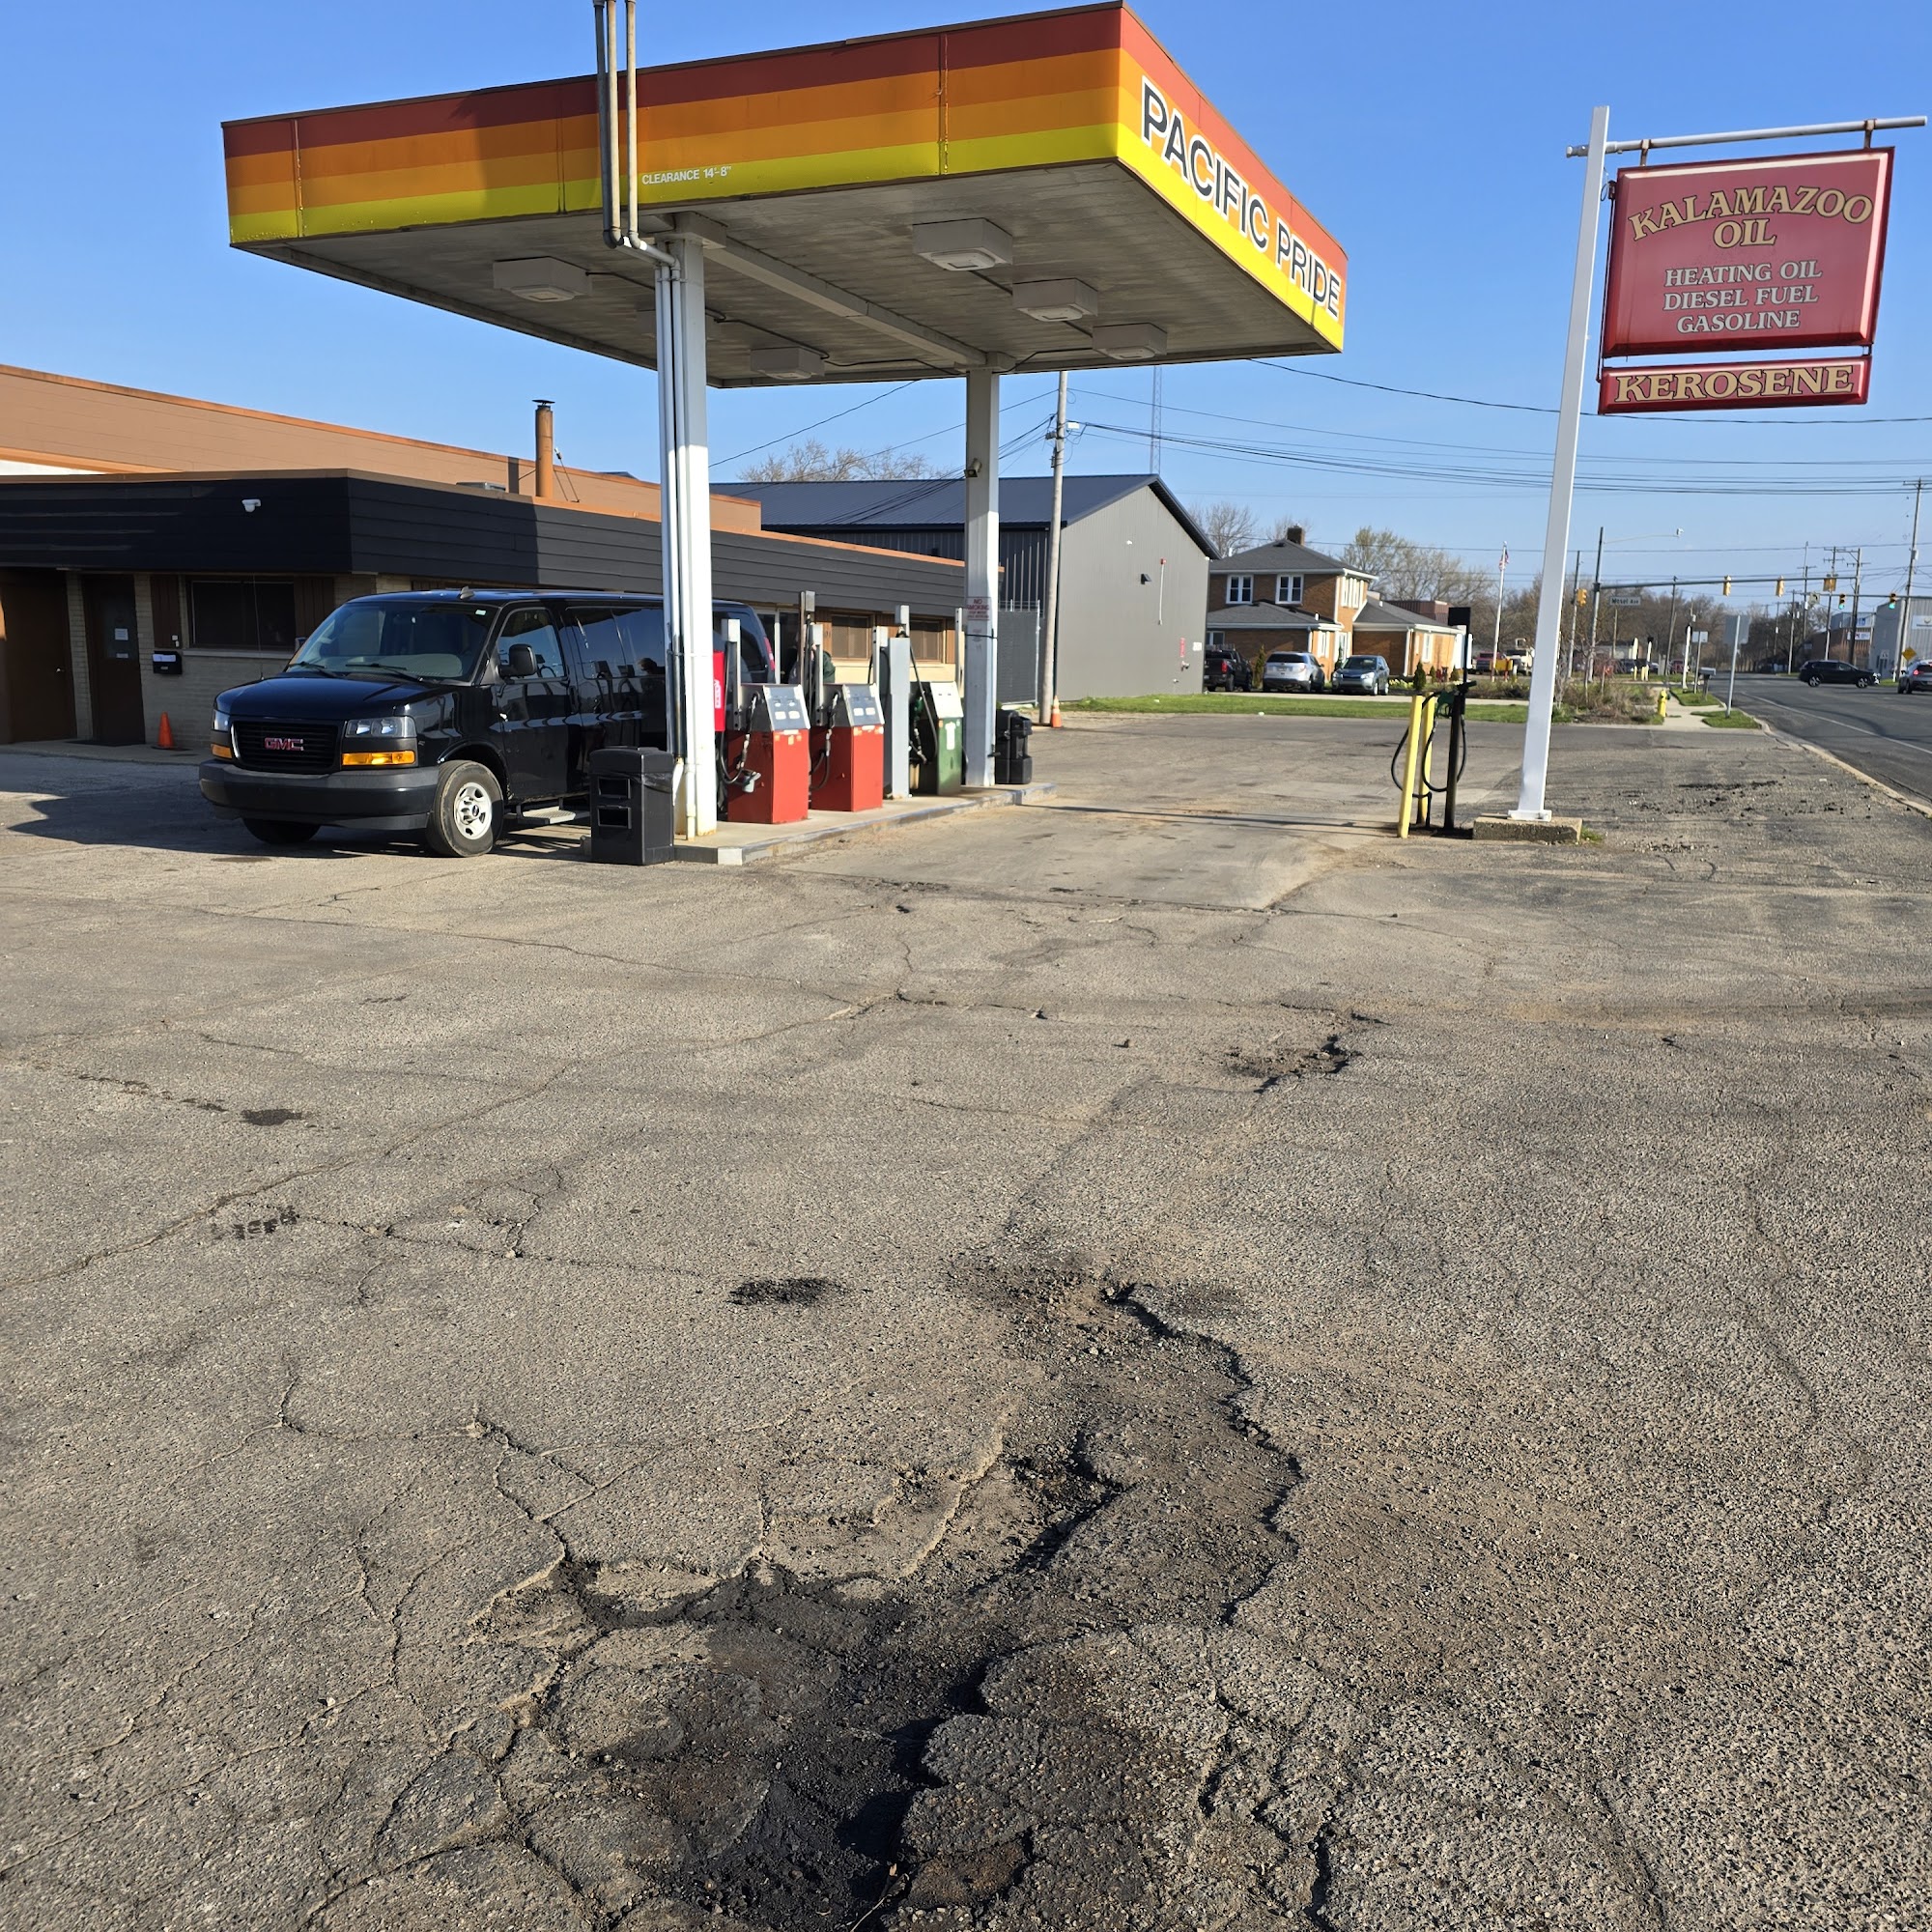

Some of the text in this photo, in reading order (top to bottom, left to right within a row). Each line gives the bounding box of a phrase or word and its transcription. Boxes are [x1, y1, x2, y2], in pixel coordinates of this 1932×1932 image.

[641, 169, 700, 185] CLEARANCE
[1142, 75, 1341, 322] PACIFIC PRIDE
[1629, 185, 1873, 241] KALAMAZOO
[1714, 218, 1776, 248] OIL
[1664, 260, 1823, 287] HEATING OIL
[1662, 285, 1819, 311] DIESEL FUEL
[1676, 310, 1801, 334] GASOLINE
[1615, 365, 1854, 403] KEROSENE
[264, 737, 304, 752] GMC
